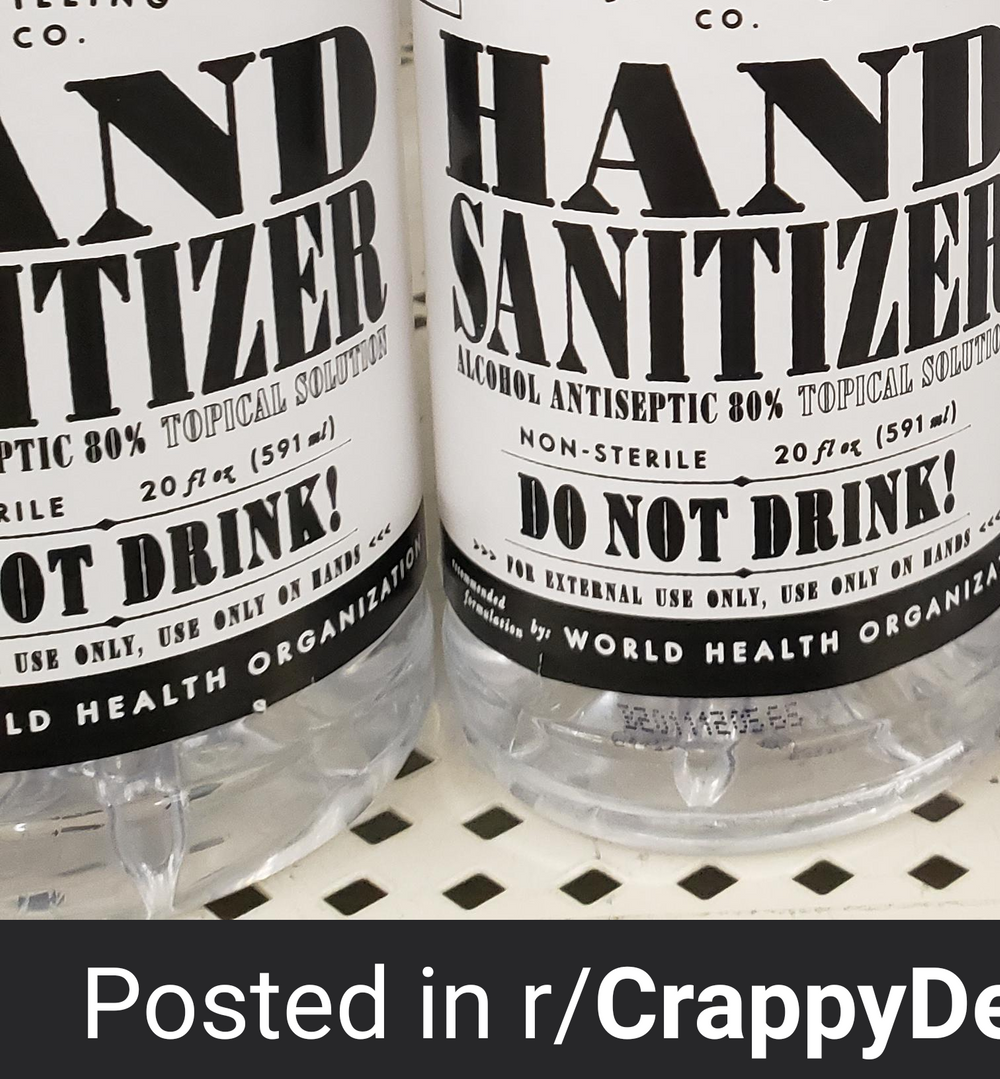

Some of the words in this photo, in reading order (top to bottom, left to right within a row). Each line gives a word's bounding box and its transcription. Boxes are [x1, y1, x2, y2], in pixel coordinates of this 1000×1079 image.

[13, 24, 85, 48] CO.
[695, 9, 759, 30] CO.
[84, 423, 146, 464] 80%
[161, 382, 287, 449] TOPICAL
[295, 325, 388, 406] SOLUTION
[456, 344, 541, 405] ALCOHOL
[550, 380, 718, 424] ANTISEPTIC
[728, 387, 783, 423] 80%
[798, 363, 913, 416] TOPICAL
[140, 475, 177, 502] 20
[183, 468, 206, 498] fl
[251, 433, 301, 474] (591
[308, 415, 336, 446] ml)
[520, 426, 707, 469] NON-STERILE
[775, 443, 808, 464] 20
[813, 440, 835, 465] fl
[876, 415, 923, 449] (591
[929, 400, 957, 429] ml)
[0, 544, 93, 624] OT
[118, 466, 341, 607] DRINK!
[518, 471, 586, 550] DO
[603, 492, 728, 562] NOT
[750, 450, 956, 560] DRINK!
[15, 648, 59, 673] USE
[75, 634, 144, 666] ONLY,
[159, 618, 200, 648] USE
[214, 593, 266, 631] ONLY
[278, 578, 301, 606] ON
[312, 544, 361, 591] HANDS
[451, 559, 507, 610] recommended
[506, 554, 535, 583] FOR
[545, 569, 643, 605] EXTERNAL
[655, 588, 693, 608] USE
[706, 588, 767, 610] ONLY,
[781, 580, 818, 604] USE
[831, 566, 879, 596] ONLY
[891, 555, 913, 579] ON
[923, 527, 971, 568] HANDS
[77, 666, 227, 726] HEALTH
[247, 532, 422, 675] ORGANIZATION
[463, 589, 523, 639] formulation
[530, 619, 551, 642] by:
[563, 626, 683, 663] WORLD
[706, 629, 839, 663] HEALTH
